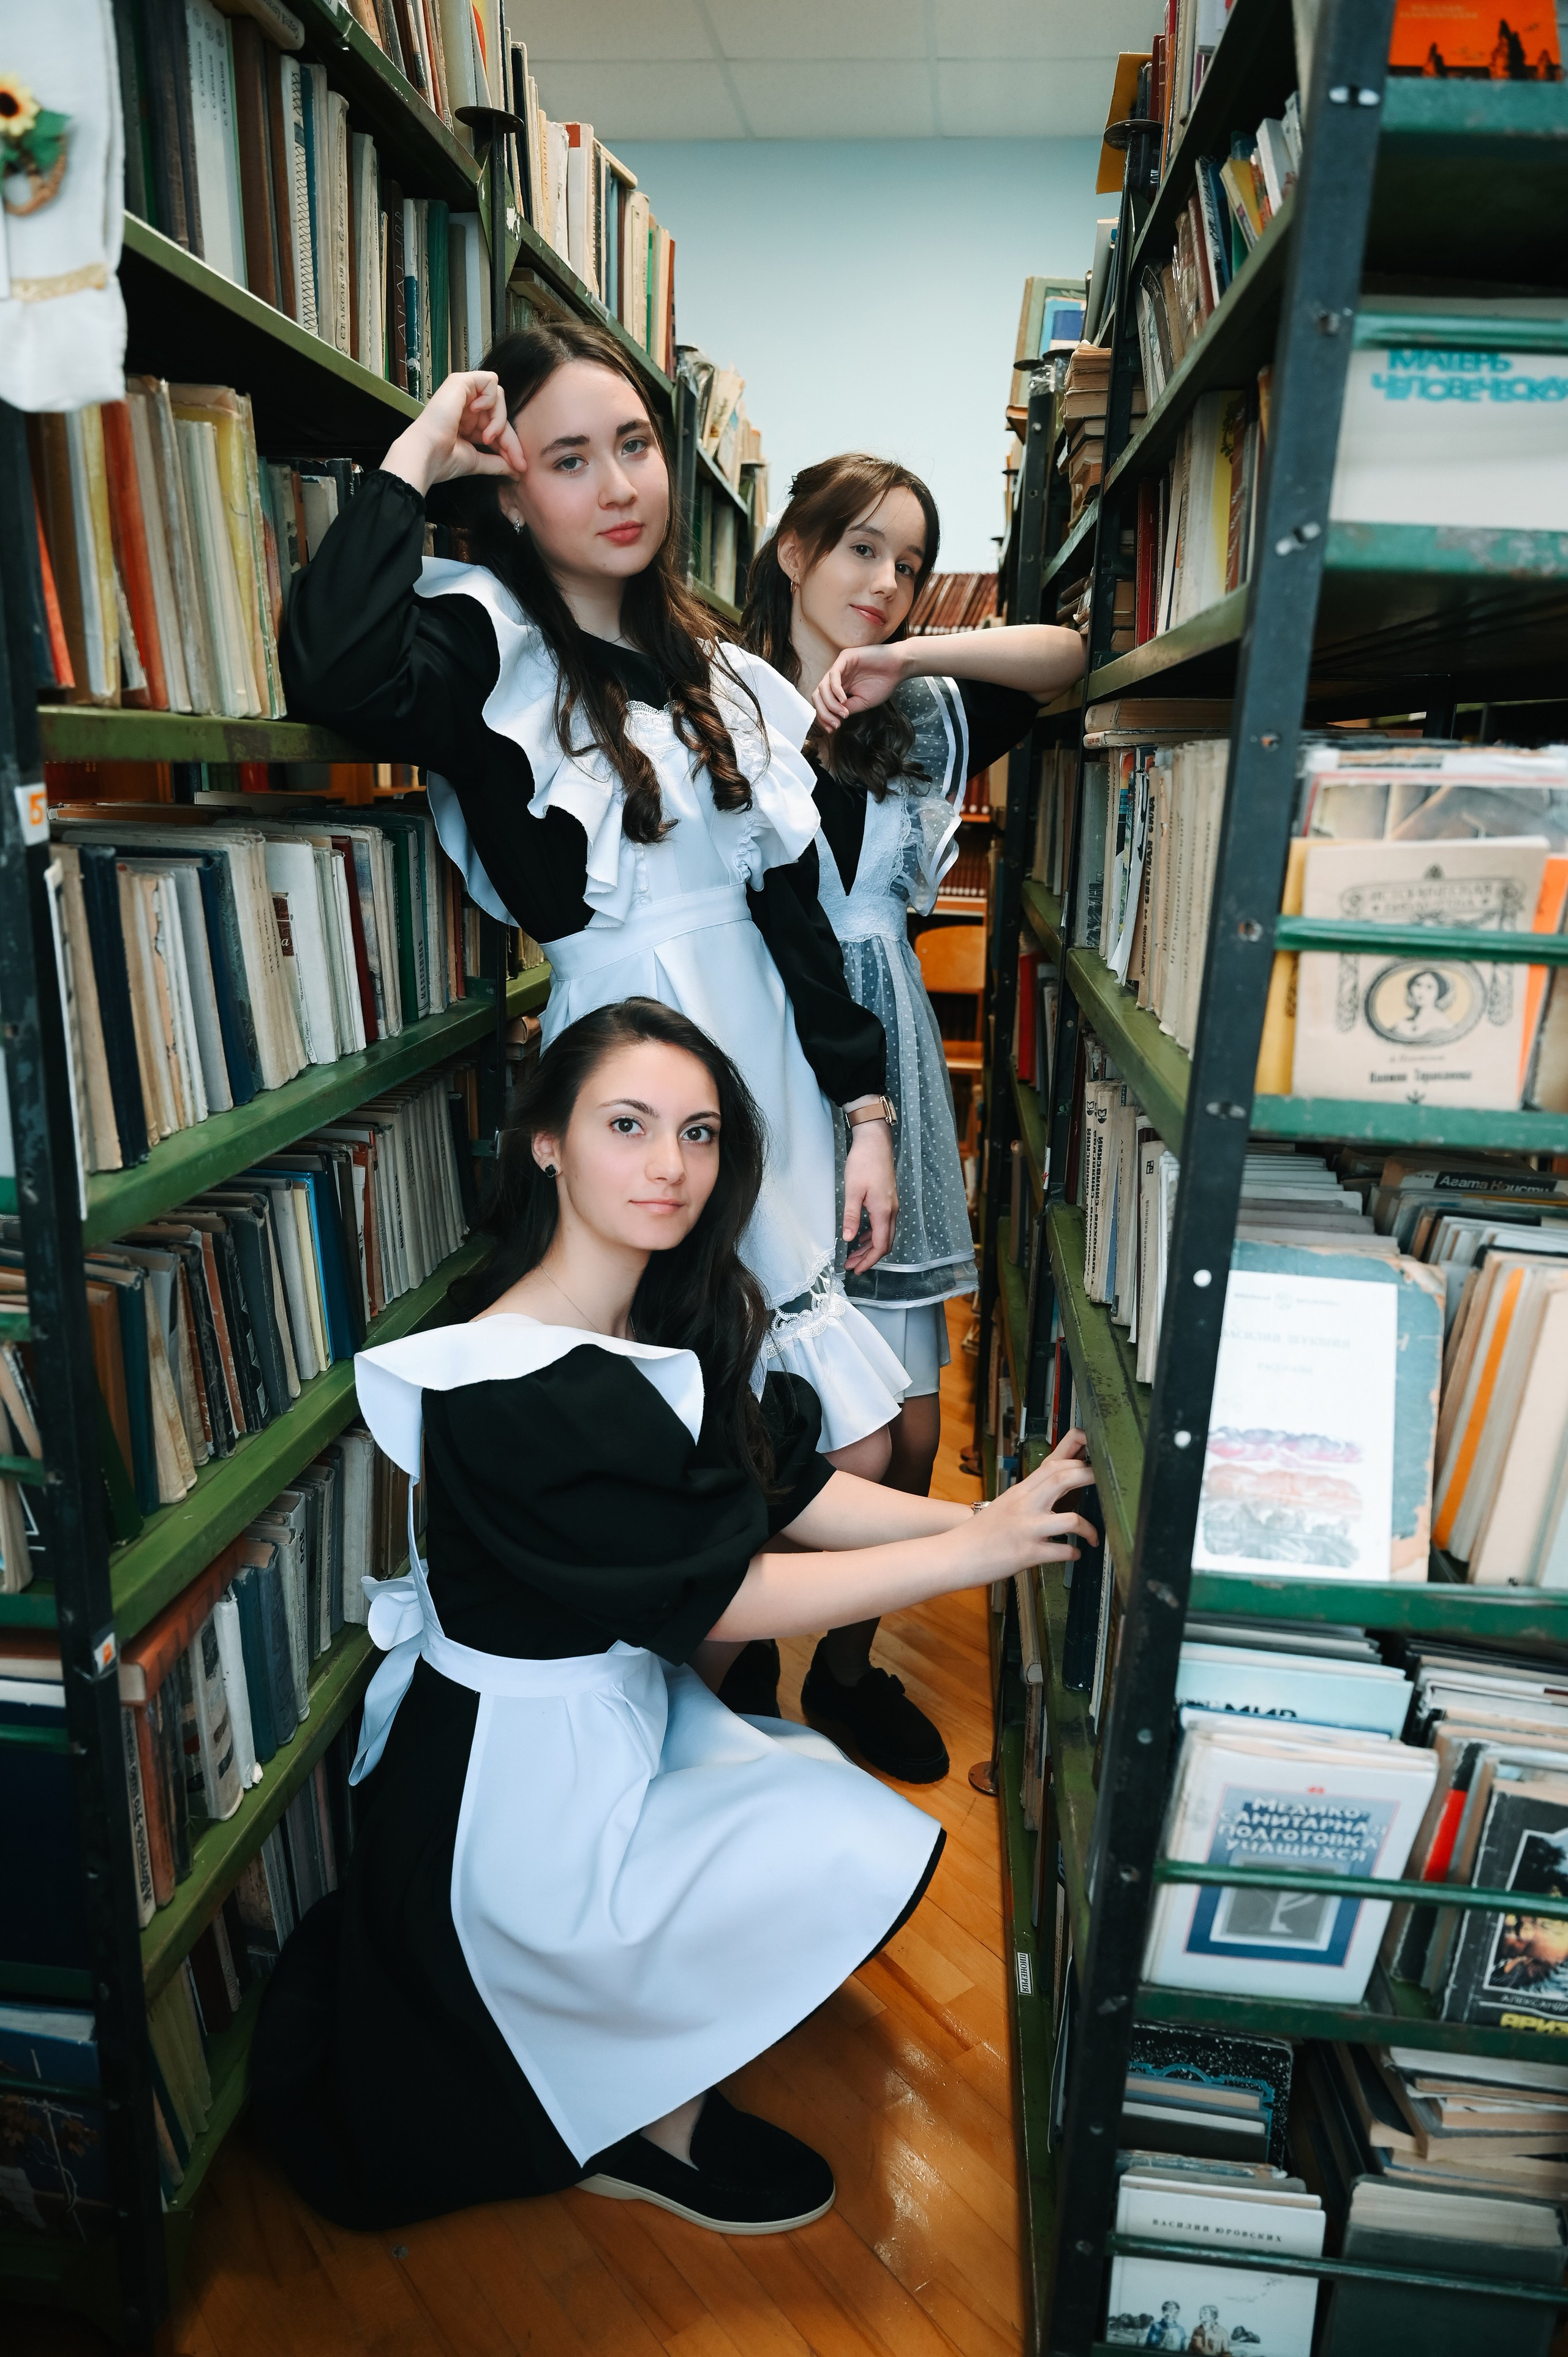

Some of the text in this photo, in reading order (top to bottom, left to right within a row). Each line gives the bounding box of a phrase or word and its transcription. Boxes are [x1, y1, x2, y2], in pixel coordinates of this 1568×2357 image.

[1388, 349, 1513, 372] МАТЕРЬ
[1370, 372, 1568, 402] ЧЕЛОВЕЧЕСКА
[1144, 840, 1153, 904] СВЕТЛАЯ
[1439, 1175, 1488, 1190] Агата
[1092, 1136, 1103, 1274] ШОЛОХОВ-СИНЯВСКИЙ
[1020, 1954, 1029, 1993] ПИОНЕРИЯ
[1152, 2217, 1282, 2242] ВАСИЛИЙ ЮРОВСКИХ
